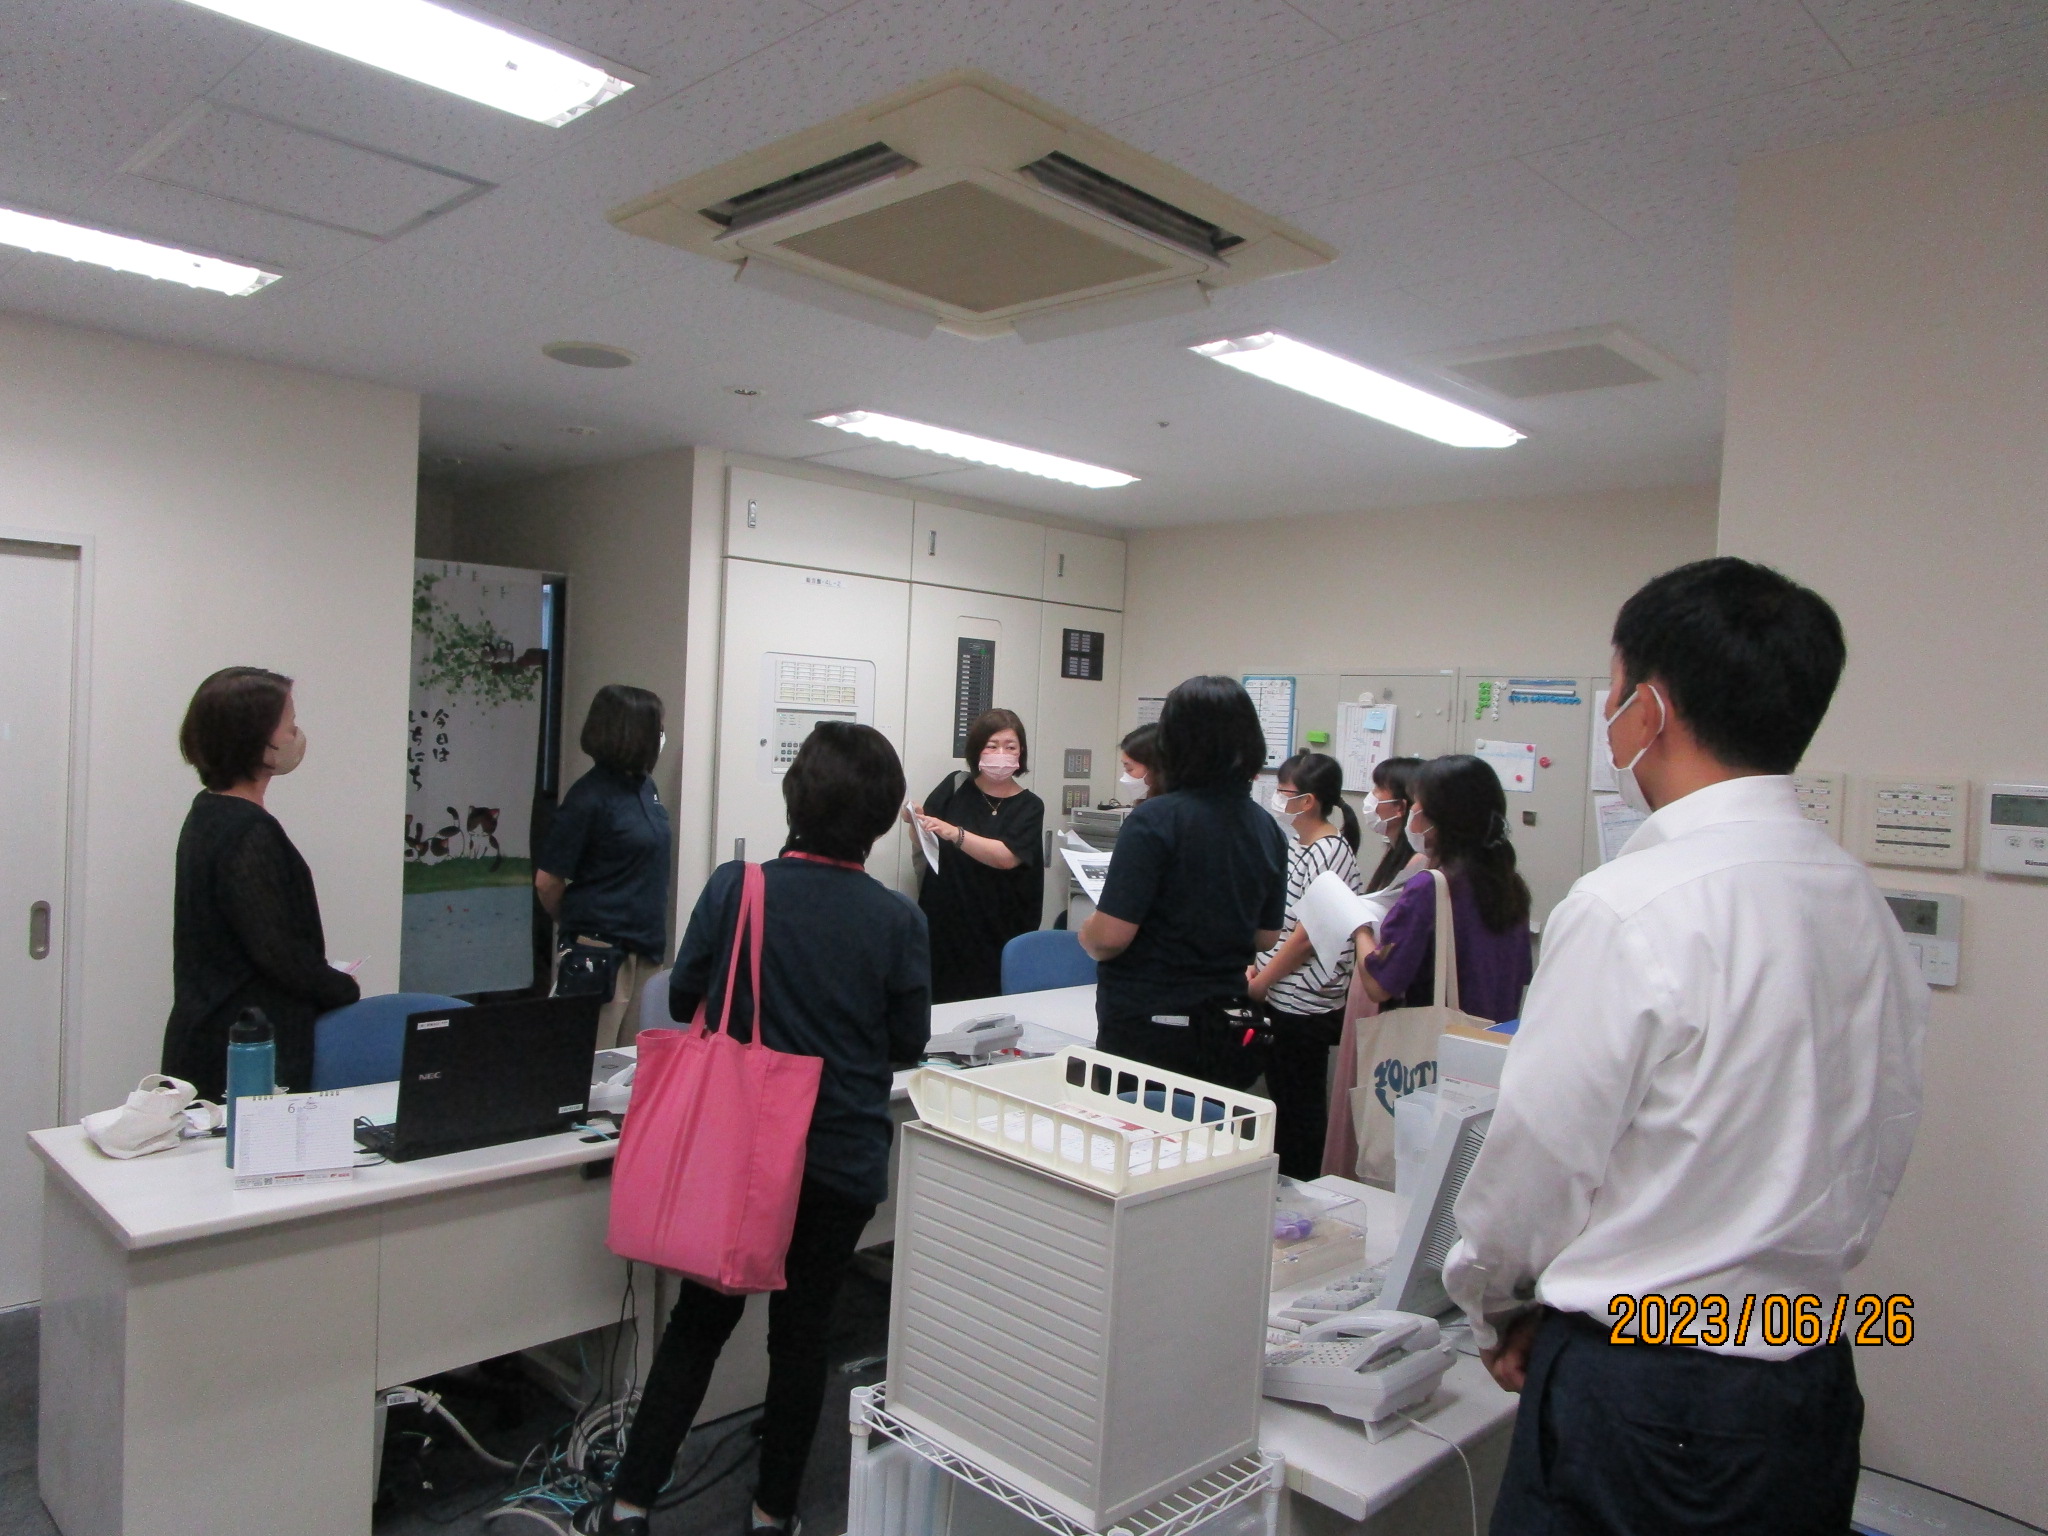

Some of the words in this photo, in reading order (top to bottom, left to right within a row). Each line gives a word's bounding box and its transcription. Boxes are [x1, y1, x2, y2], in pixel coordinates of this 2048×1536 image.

[407, 709, 429, 792] いちにち
[432, 708, 450, 763] 今日は
[418, 1071, 442, 1081] NEC
[287, 1102, 296, 1114] 6
